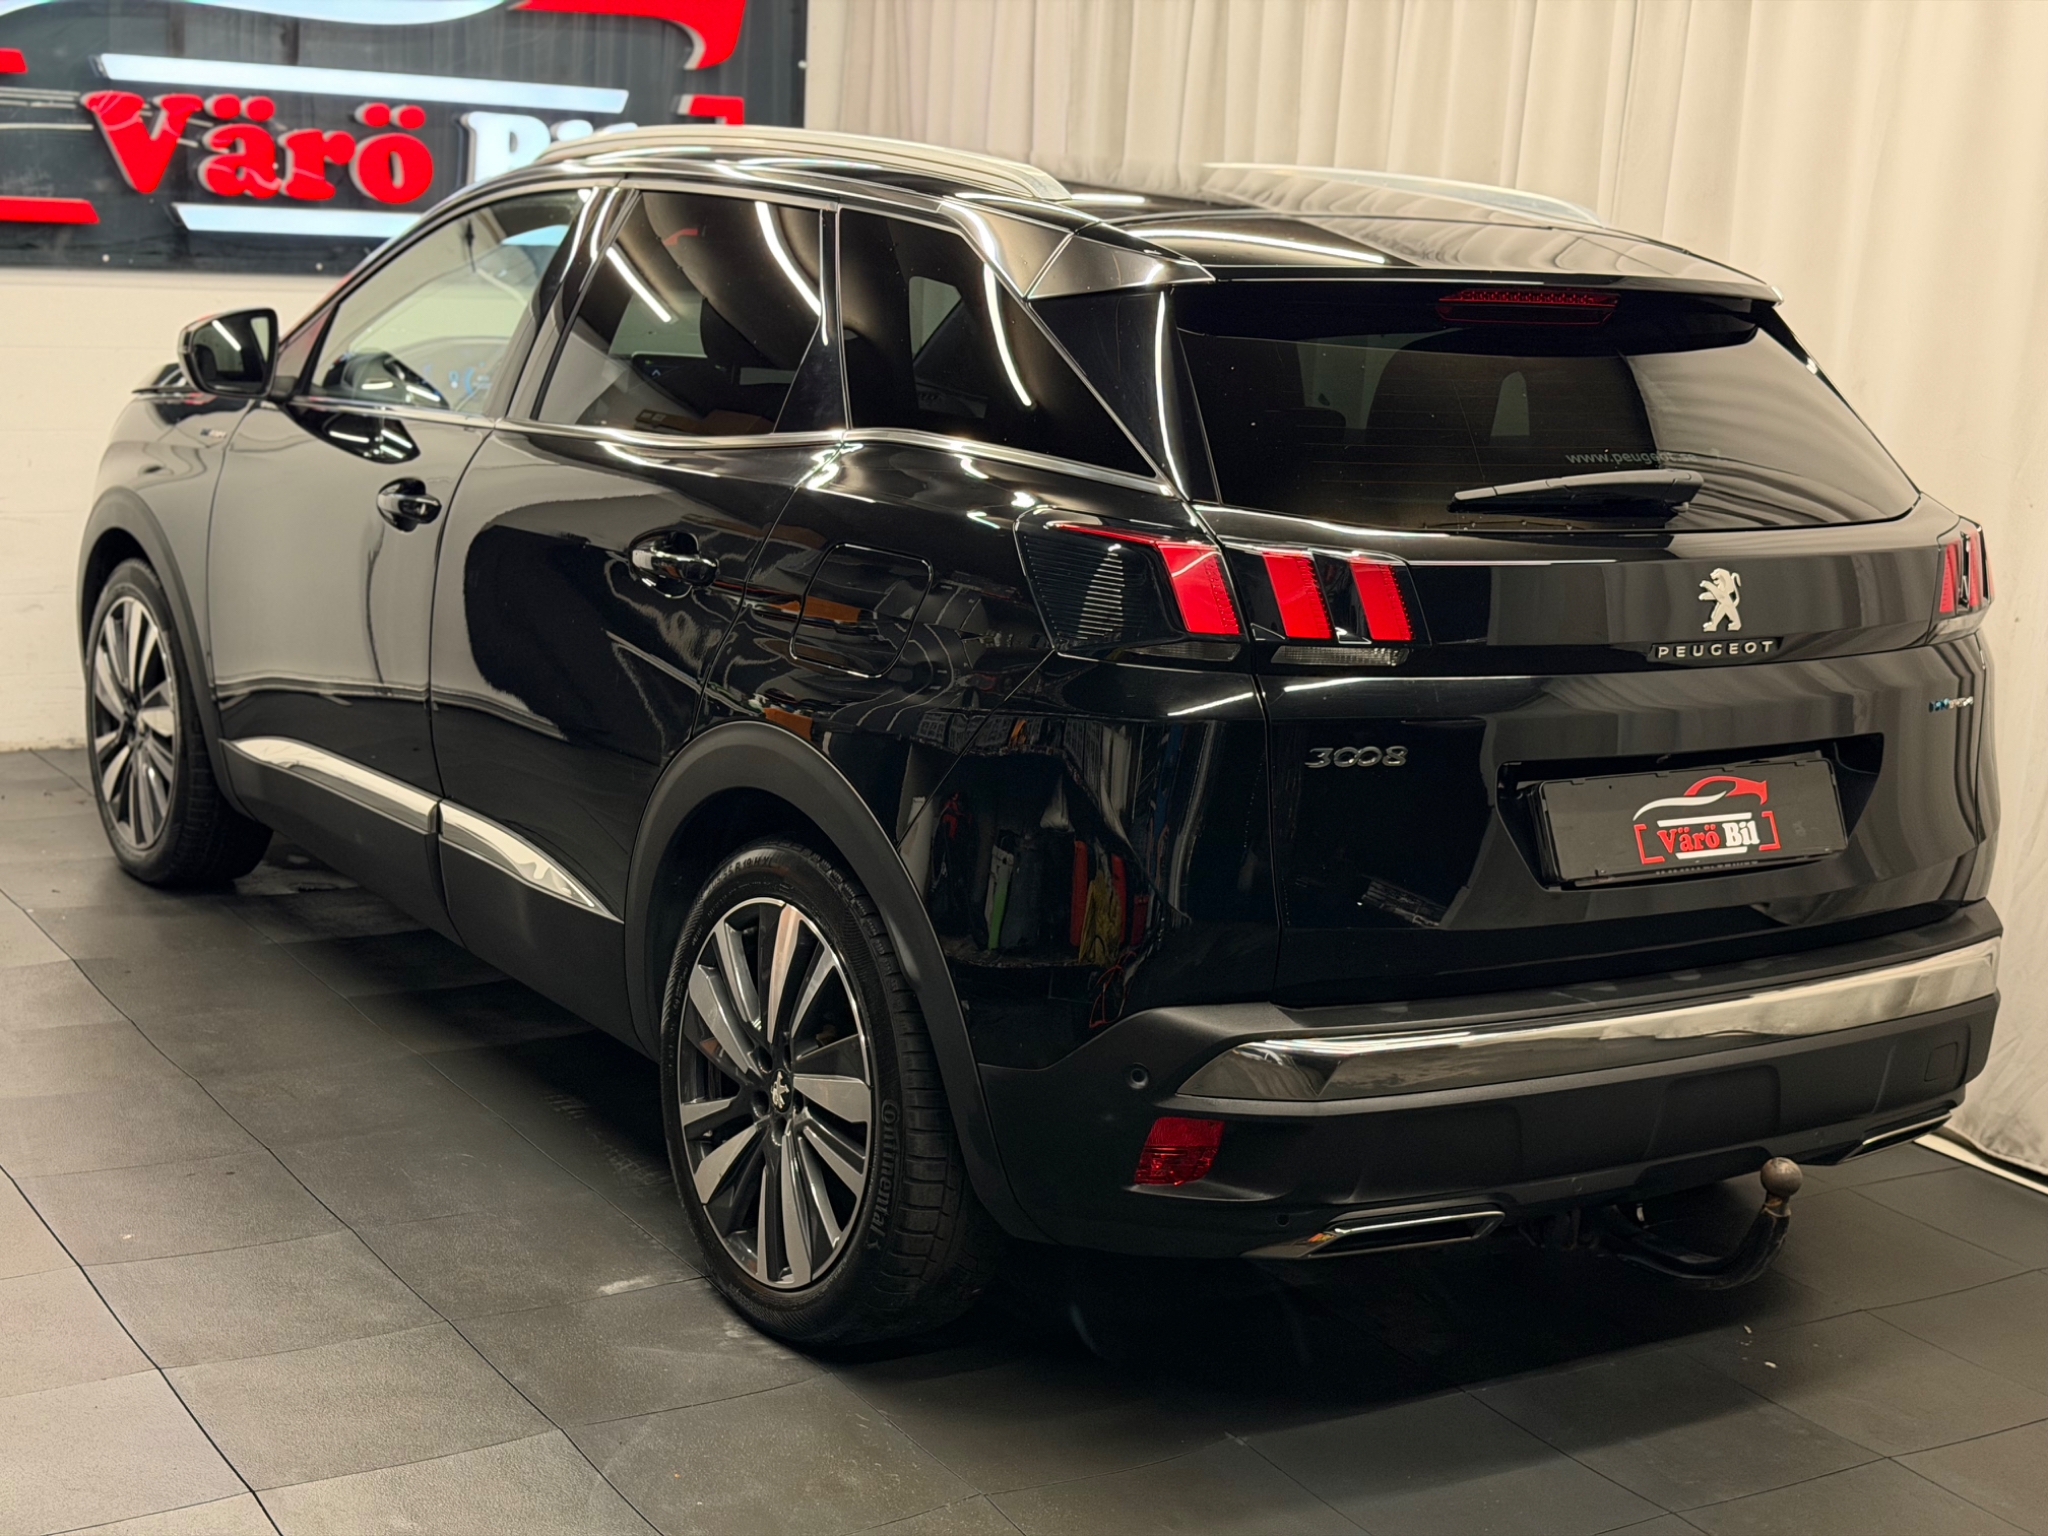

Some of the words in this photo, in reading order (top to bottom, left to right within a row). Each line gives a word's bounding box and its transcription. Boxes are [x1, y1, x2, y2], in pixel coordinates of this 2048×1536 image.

[82, 91, 434, 204] Värö
[1565, 451, 1699, 465] www.peugeot.se
[1658, 640, 1774, 658] PEUGEOT
[1304, 745, 1408, 768] 3008
[1657, 823, 1720, 853] Värö
[1722, 820, 1760, 847] Bil
[869, 1099, 898, 1238] Continental
